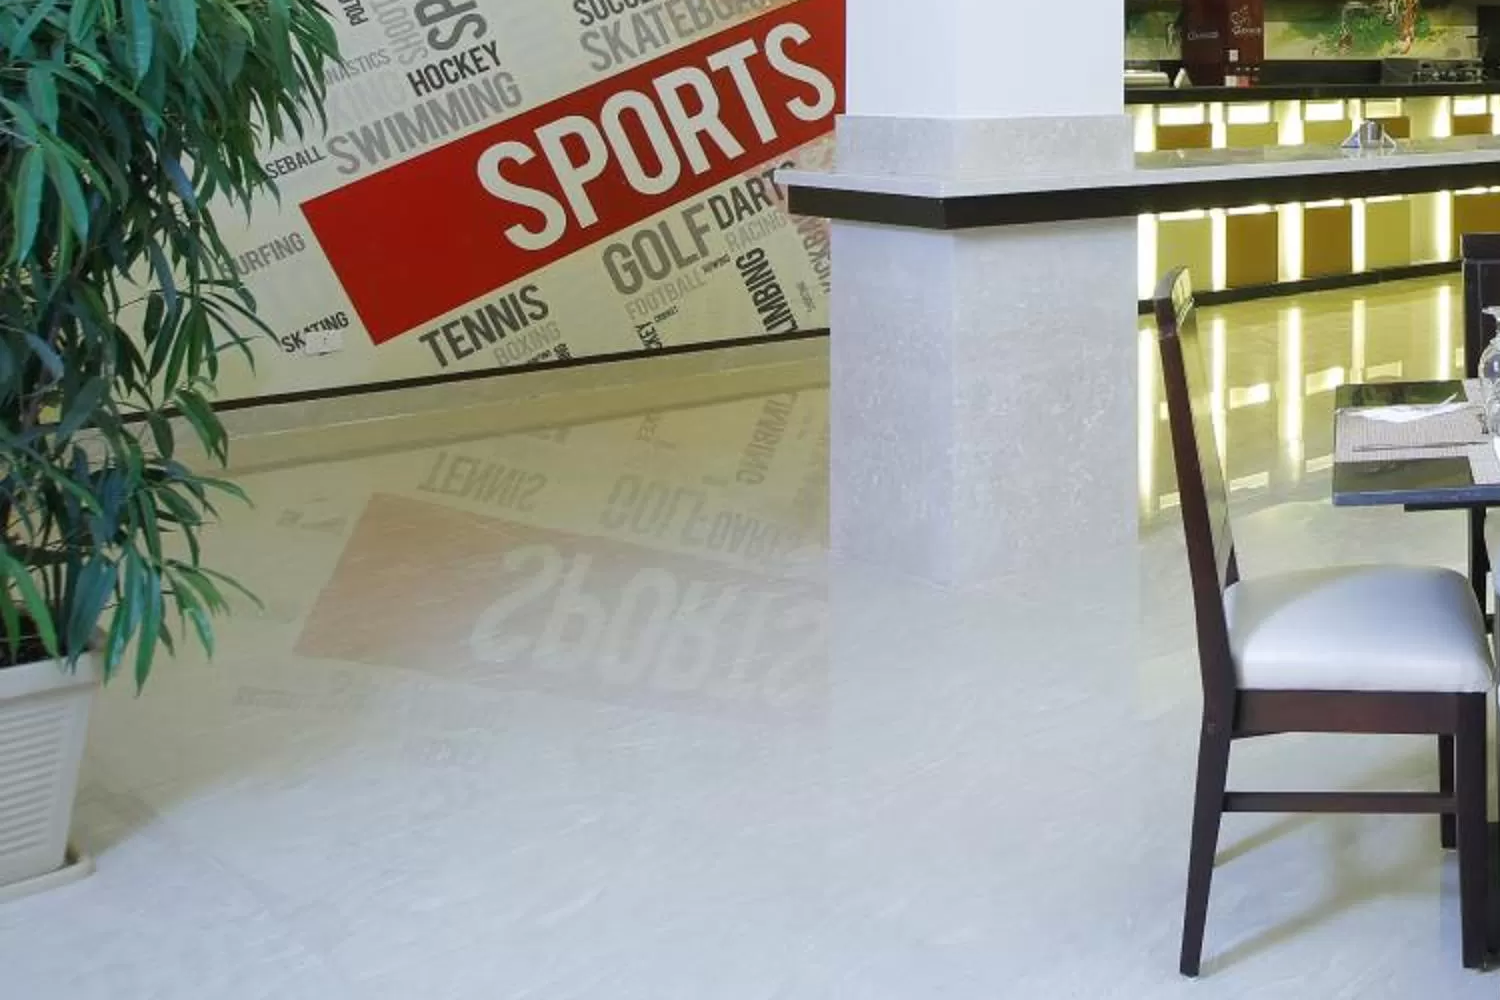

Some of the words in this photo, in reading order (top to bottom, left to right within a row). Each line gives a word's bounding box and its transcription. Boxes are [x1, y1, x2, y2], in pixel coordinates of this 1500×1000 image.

[405, 40, 502, 97] HOCKEY
[325, 71, 523, 175] SWIMMING
[476, 21, 837, 252] SPORTS
[264, 145, 328, 180] SEBALL
[226, 231, 307, 278] URFING
[601, 201, 712, 295] GOLF
[624, 264, 709, 321] FOOTBALL
[735, 246, 799, 332] LIMBING
[417, 283, 550, 370] TENNIS
[493, 319, 563, 366] BOXING
